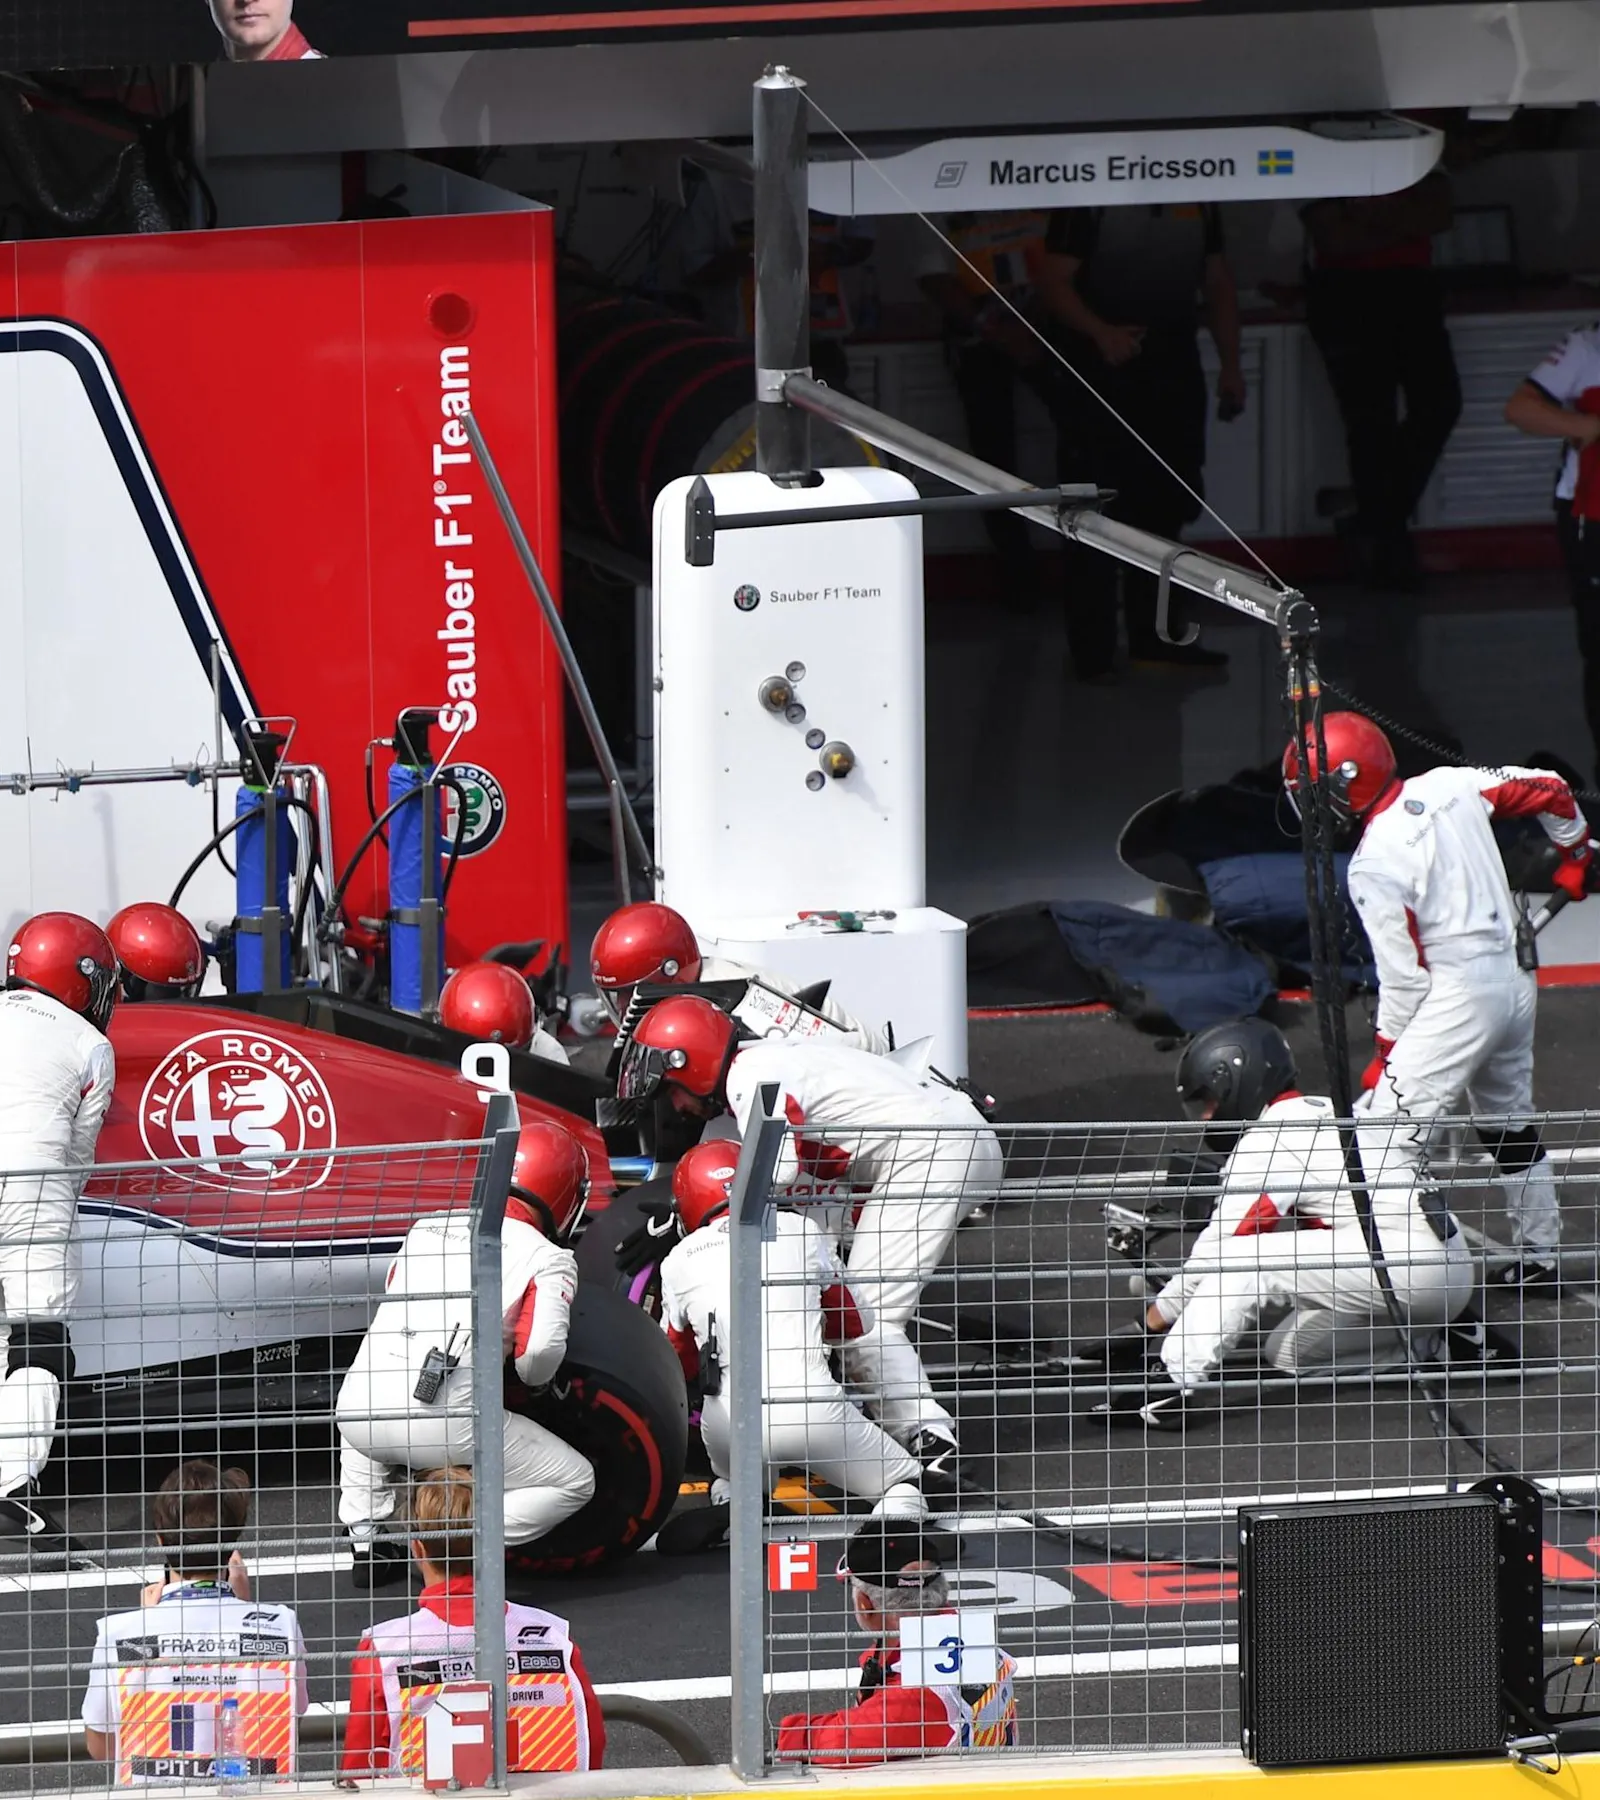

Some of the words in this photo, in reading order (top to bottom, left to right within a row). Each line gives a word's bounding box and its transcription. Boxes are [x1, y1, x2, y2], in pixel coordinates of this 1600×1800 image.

[989, 160, 1096, 186] Marcus
[1107, 155, 1236, 181] Ericsson
[432, 345, 472, 475] Team
[770, 590, 819, 603] Sauber
[845, 586, 881, 599] Team
[437, 561, 477, 733] Sauber
[454, 767, 502, 810] ROMEO
[24, 1005, 57, 1021] Team
[149, 1050, 207, 1129] ALFA
[221, 1038, 325, 1129] ROMEO
[461, 1042, 510, 1103] 9
[779, 1544, 810, 1590] F
[161, 1638, 195, 1654] FRA
[242, 1641, 288, 1655] 2018
[934, 1636, 965, 1674] 3
[520, 1656, 561, 1669] 2018
[173, 1675, 210, 1685] MEDICAL
[213, 1675, 237, 1685] TEAM
[512, 1690, 544, 1702] DRIVER
[426, 1691, 490, 1781] F
[155, 1760, 190, 1776] PIT
